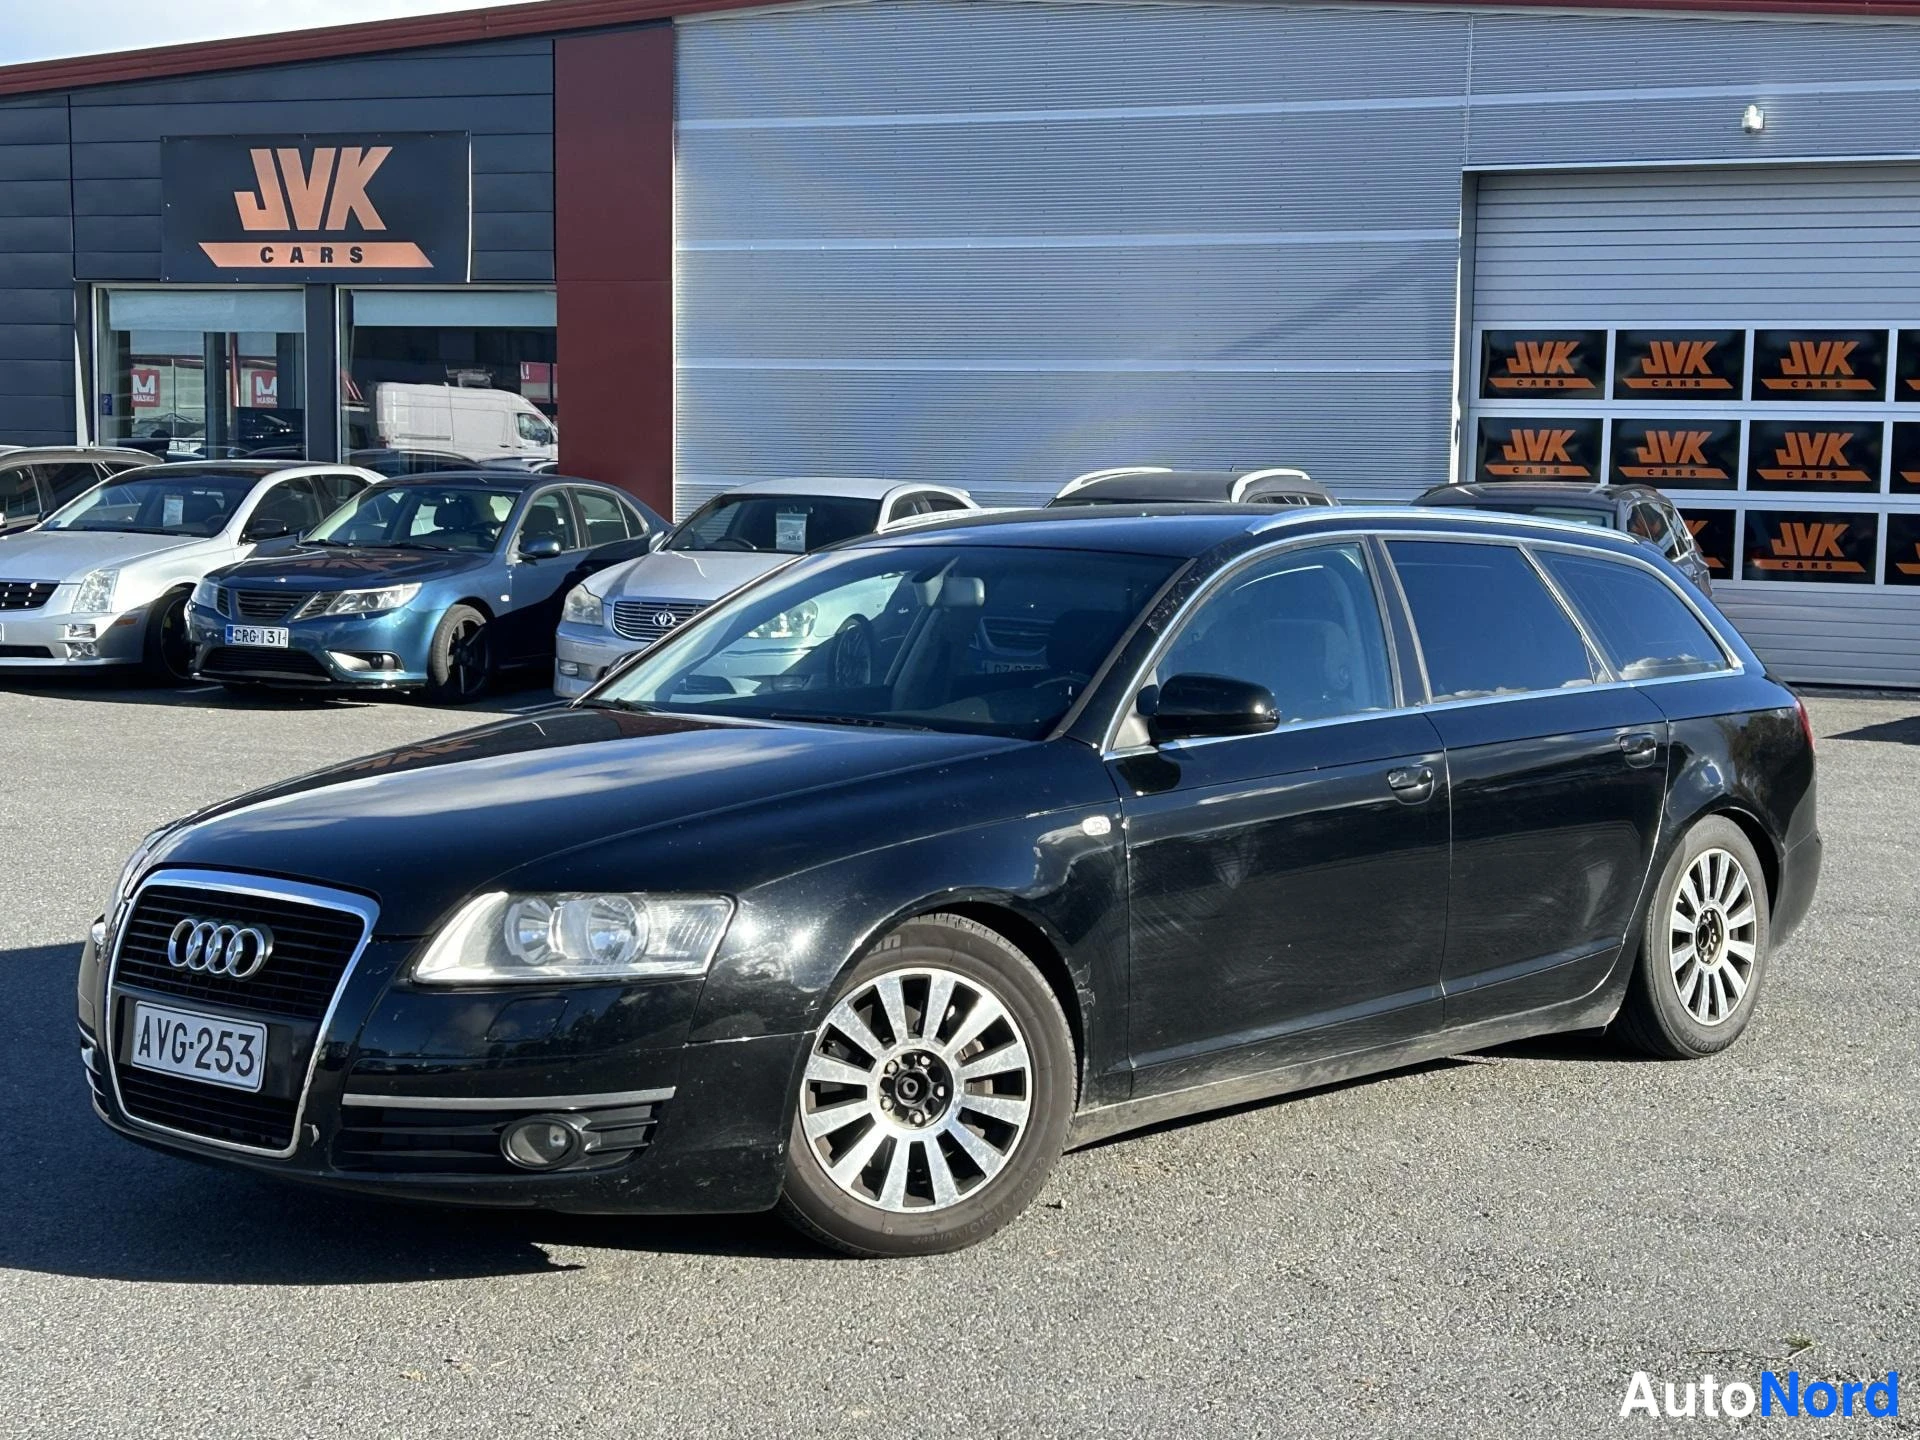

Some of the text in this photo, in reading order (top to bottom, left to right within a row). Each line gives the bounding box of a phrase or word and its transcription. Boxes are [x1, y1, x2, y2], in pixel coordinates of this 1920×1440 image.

[233, 146, 393, 231] JVK
[260, 246, 363, 264] CARS
[1506, 341, 1580, 374] JVK
[1640, 341, 1718, 375] JVK
[1779, 341, 1860, 375] JVK
[1651, 379, 1701, 387] CARS
[1791, 380, 1842, 388] CARS
[1502, 429, 1576, 462] JVK
[1636, 431, 1713, 464] JVK
[1775, 432, 1854, 466] JVK
[1512, 466, 1560, 474] CARS
[1786, 471, 1838, 479] CARS
[1770, 522, 1851, 558] JVK
[1781, 561, 1833, 570] CARS
[234, 628, 281, 645] CRG-131
[138, 1015, 256, 1077] AVG-253
